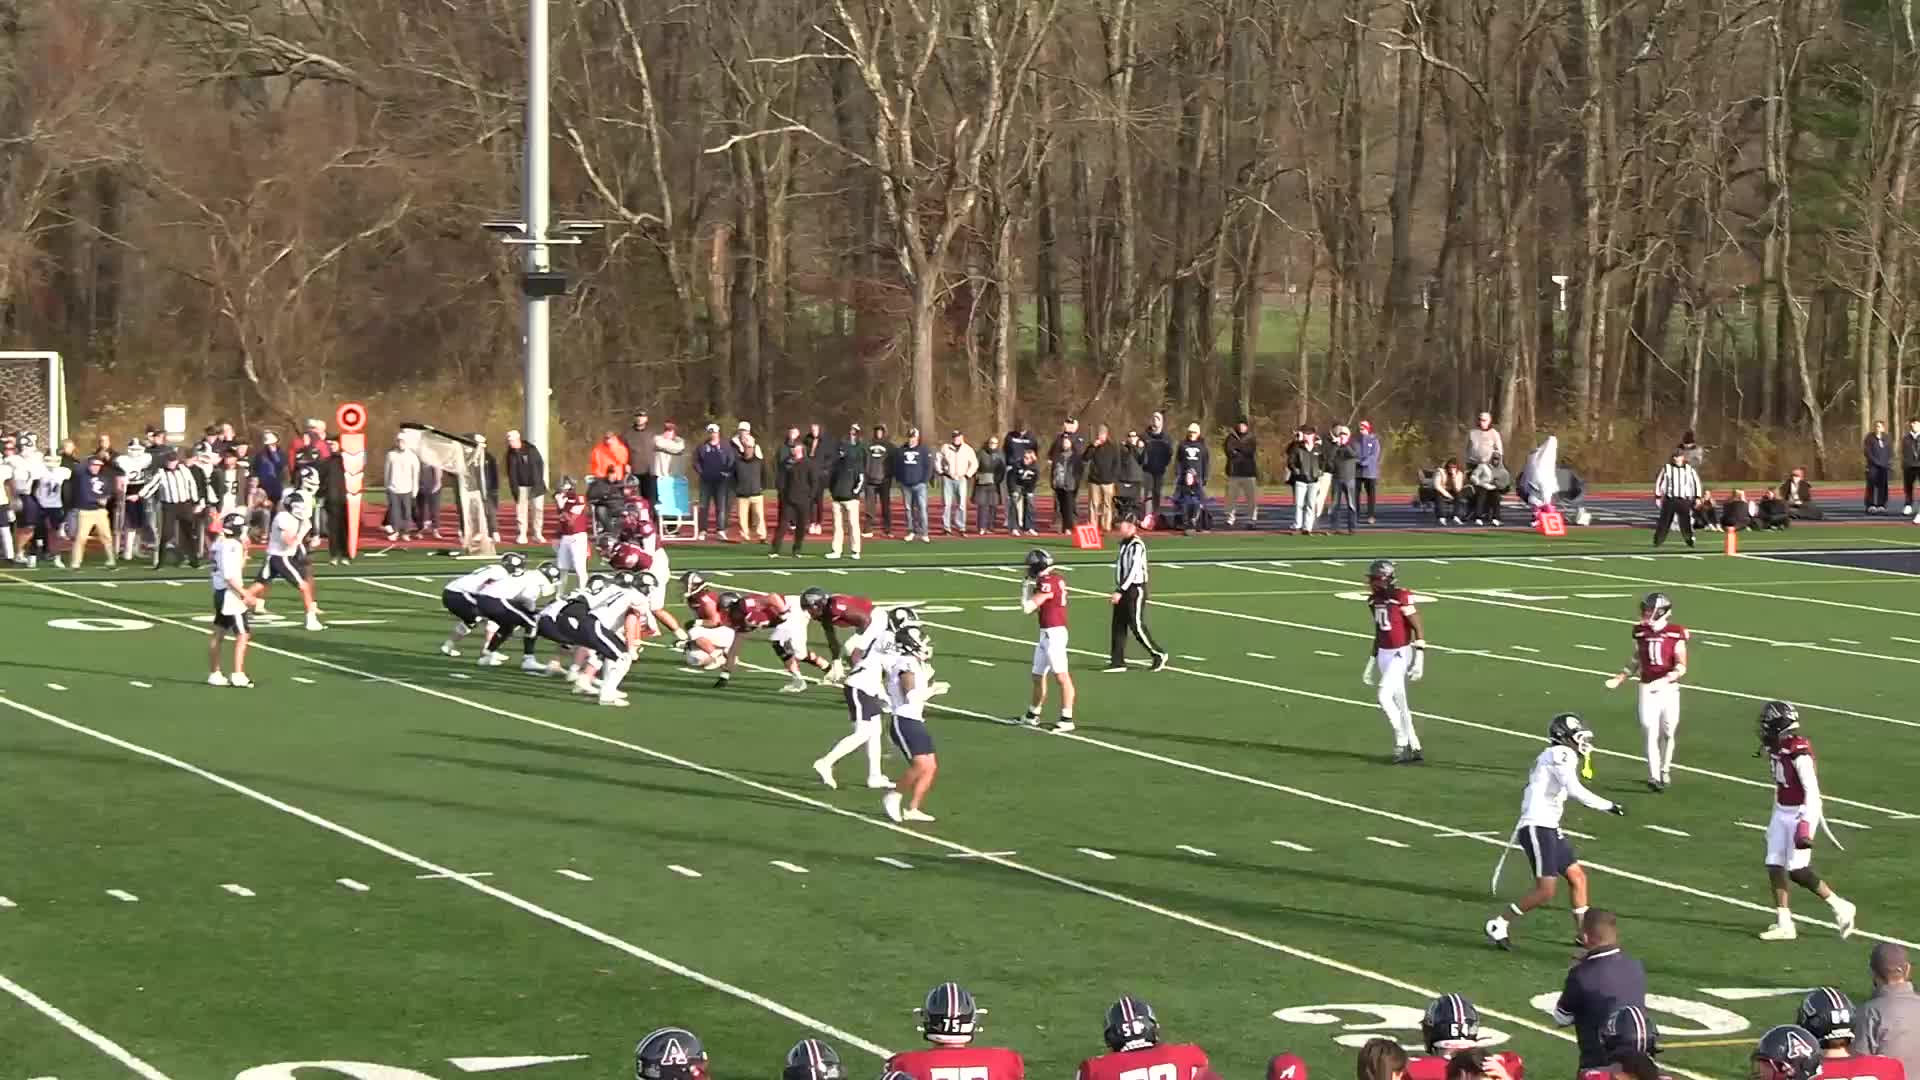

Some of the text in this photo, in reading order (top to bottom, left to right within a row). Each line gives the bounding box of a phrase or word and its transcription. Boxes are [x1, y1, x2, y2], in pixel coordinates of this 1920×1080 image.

[1544, 514, 1560, 531] G
[1082, 526, 1098, 545] 10
[1648, 641, 1664, 666] 11
[1562, 752, 1569, 763] 2
[943, 1019, 960, 1032] 75
[661, 1038, 689, 1065] A
[1786, 1031, 1813, 1059] A
